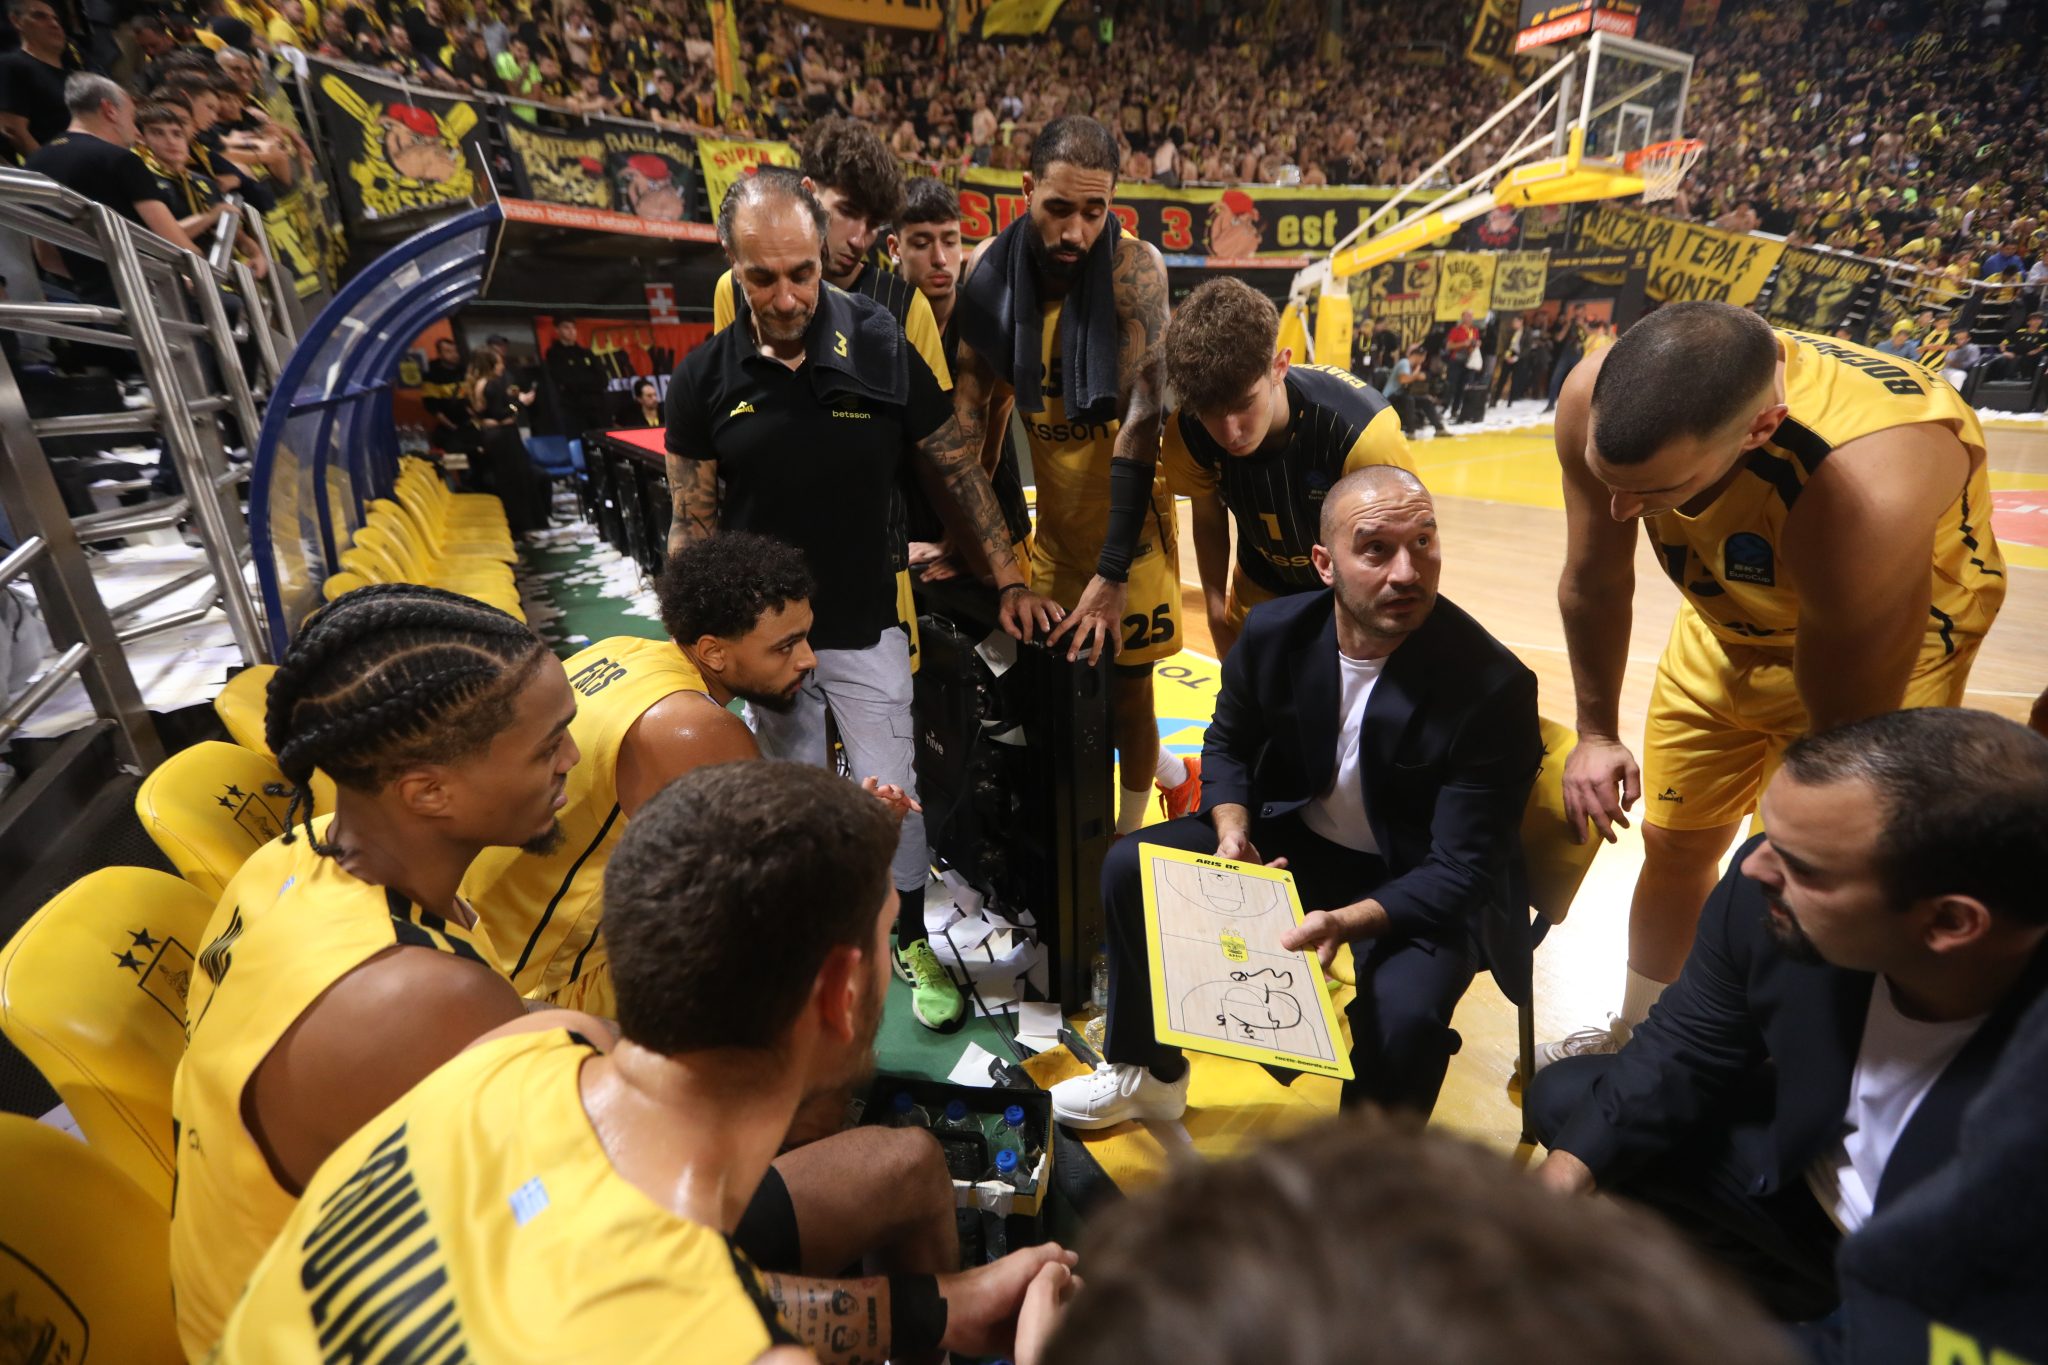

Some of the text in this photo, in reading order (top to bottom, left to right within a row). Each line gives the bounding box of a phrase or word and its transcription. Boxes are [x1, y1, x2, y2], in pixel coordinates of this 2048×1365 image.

[959, 189, 1139, 240] SUR
[1161, 207, 1192, 250] 3
[1277, 209, 1338, 247] est
[832, 410, 871, 419] betsson
[1734, 563, 1765, 574] BKT
[1729, 570, 1771, 583] EuroCup
[1122, 603, 1175, 651] 25
[1195, 858, 1222, 867] ARIS
